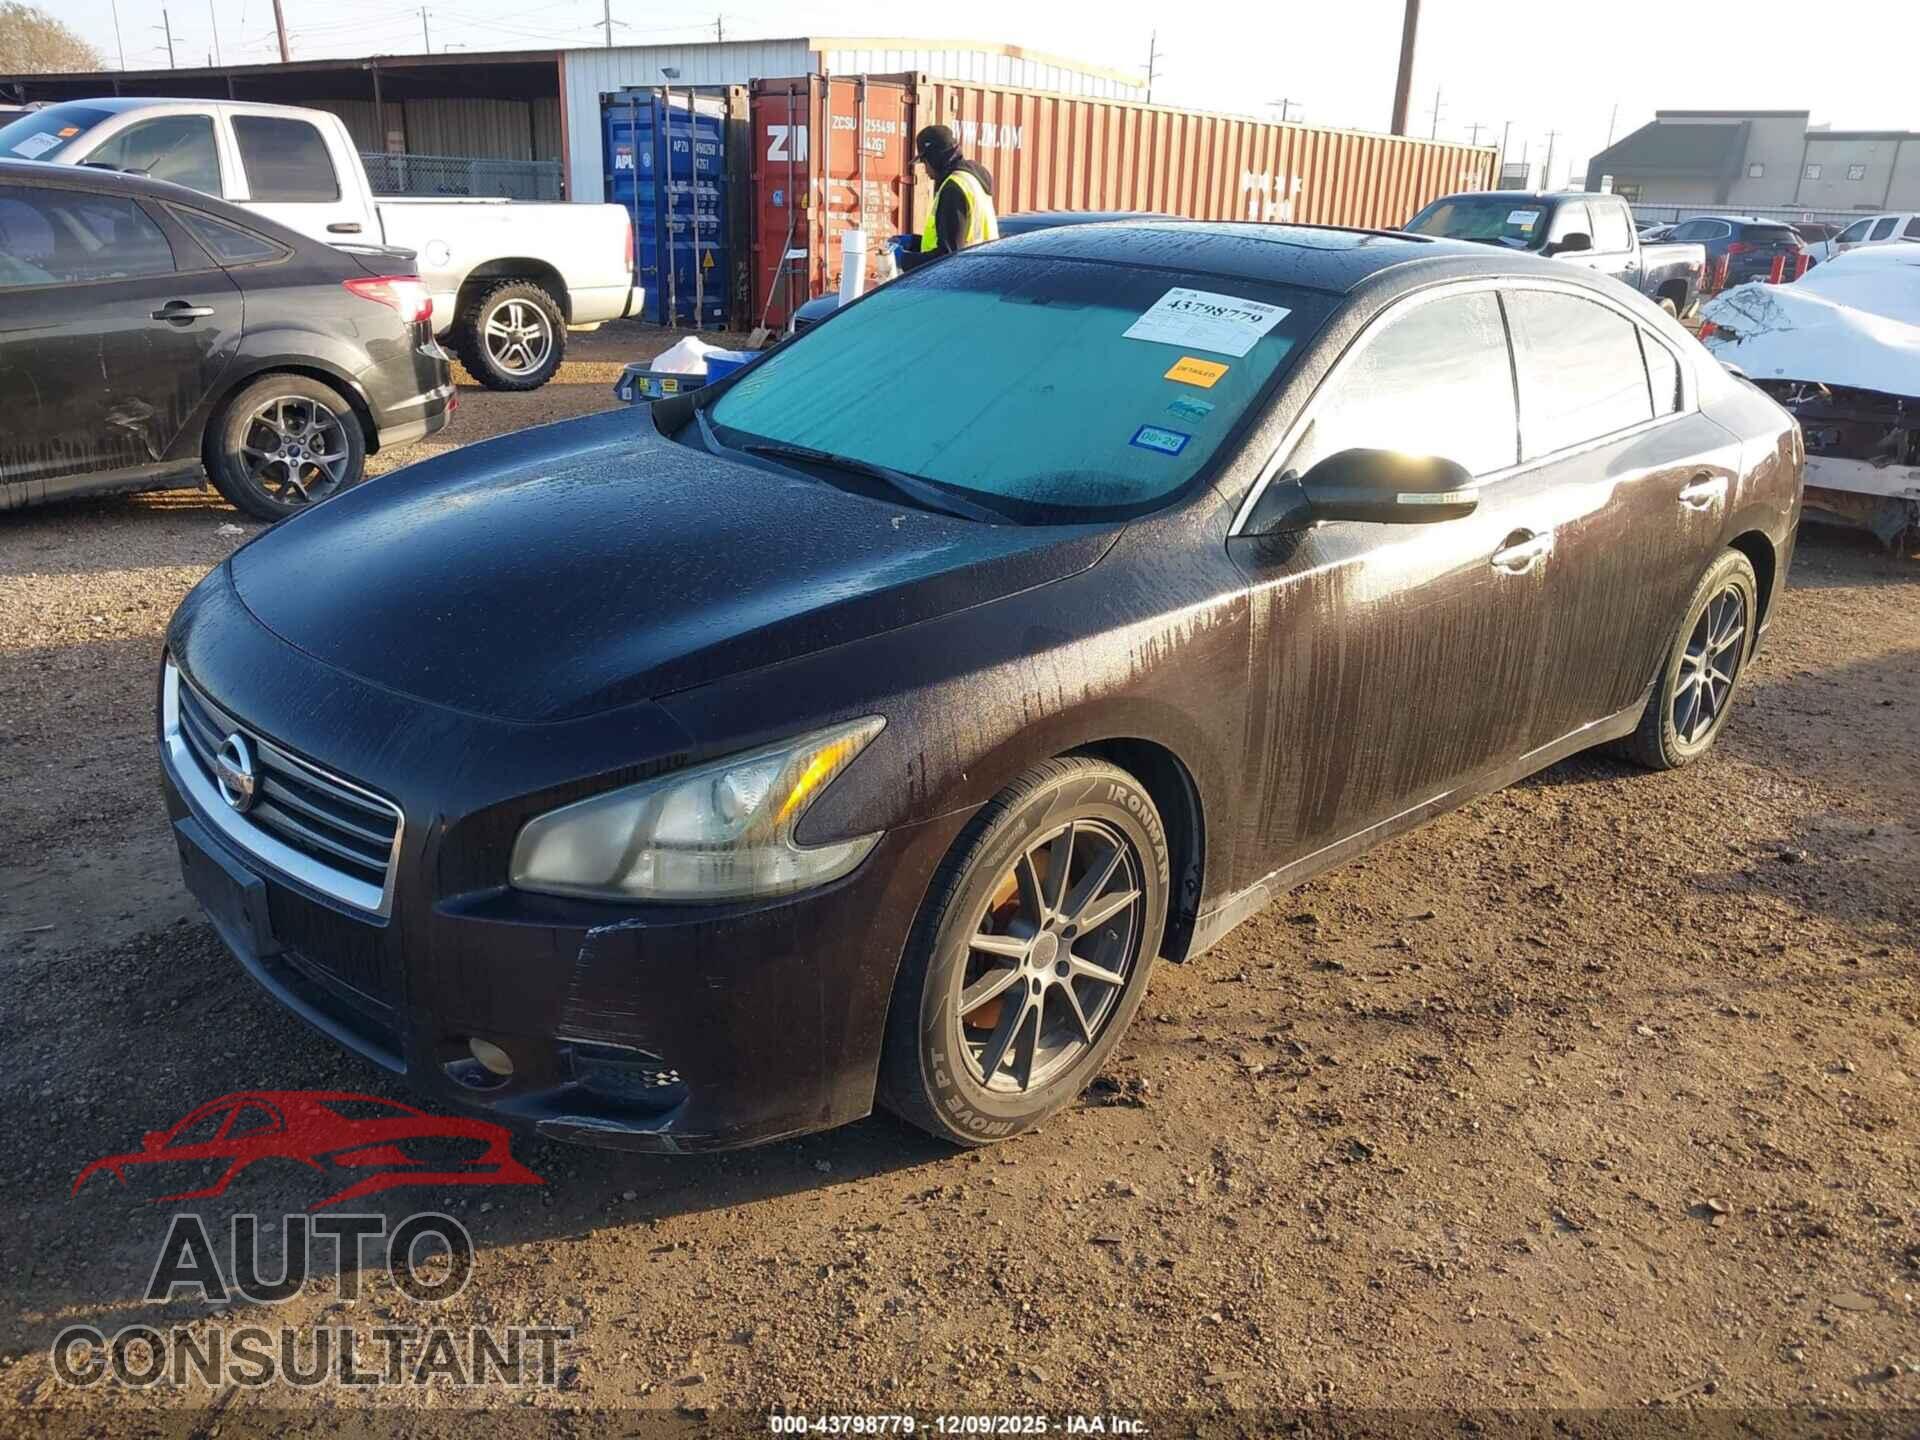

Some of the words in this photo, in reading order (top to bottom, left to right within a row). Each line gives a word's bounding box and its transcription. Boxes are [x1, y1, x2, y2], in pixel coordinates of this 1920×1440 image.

[831, 115, 857, 130] ZCSU
[673, 140, 689, 152] APZU
[615, 154, 634, 169] APL
[1167, 299, 1263, 323] 43798779
[1107, 784, 1169, 884] IRONMAN
[931, 1049, 949, 1088] PT
